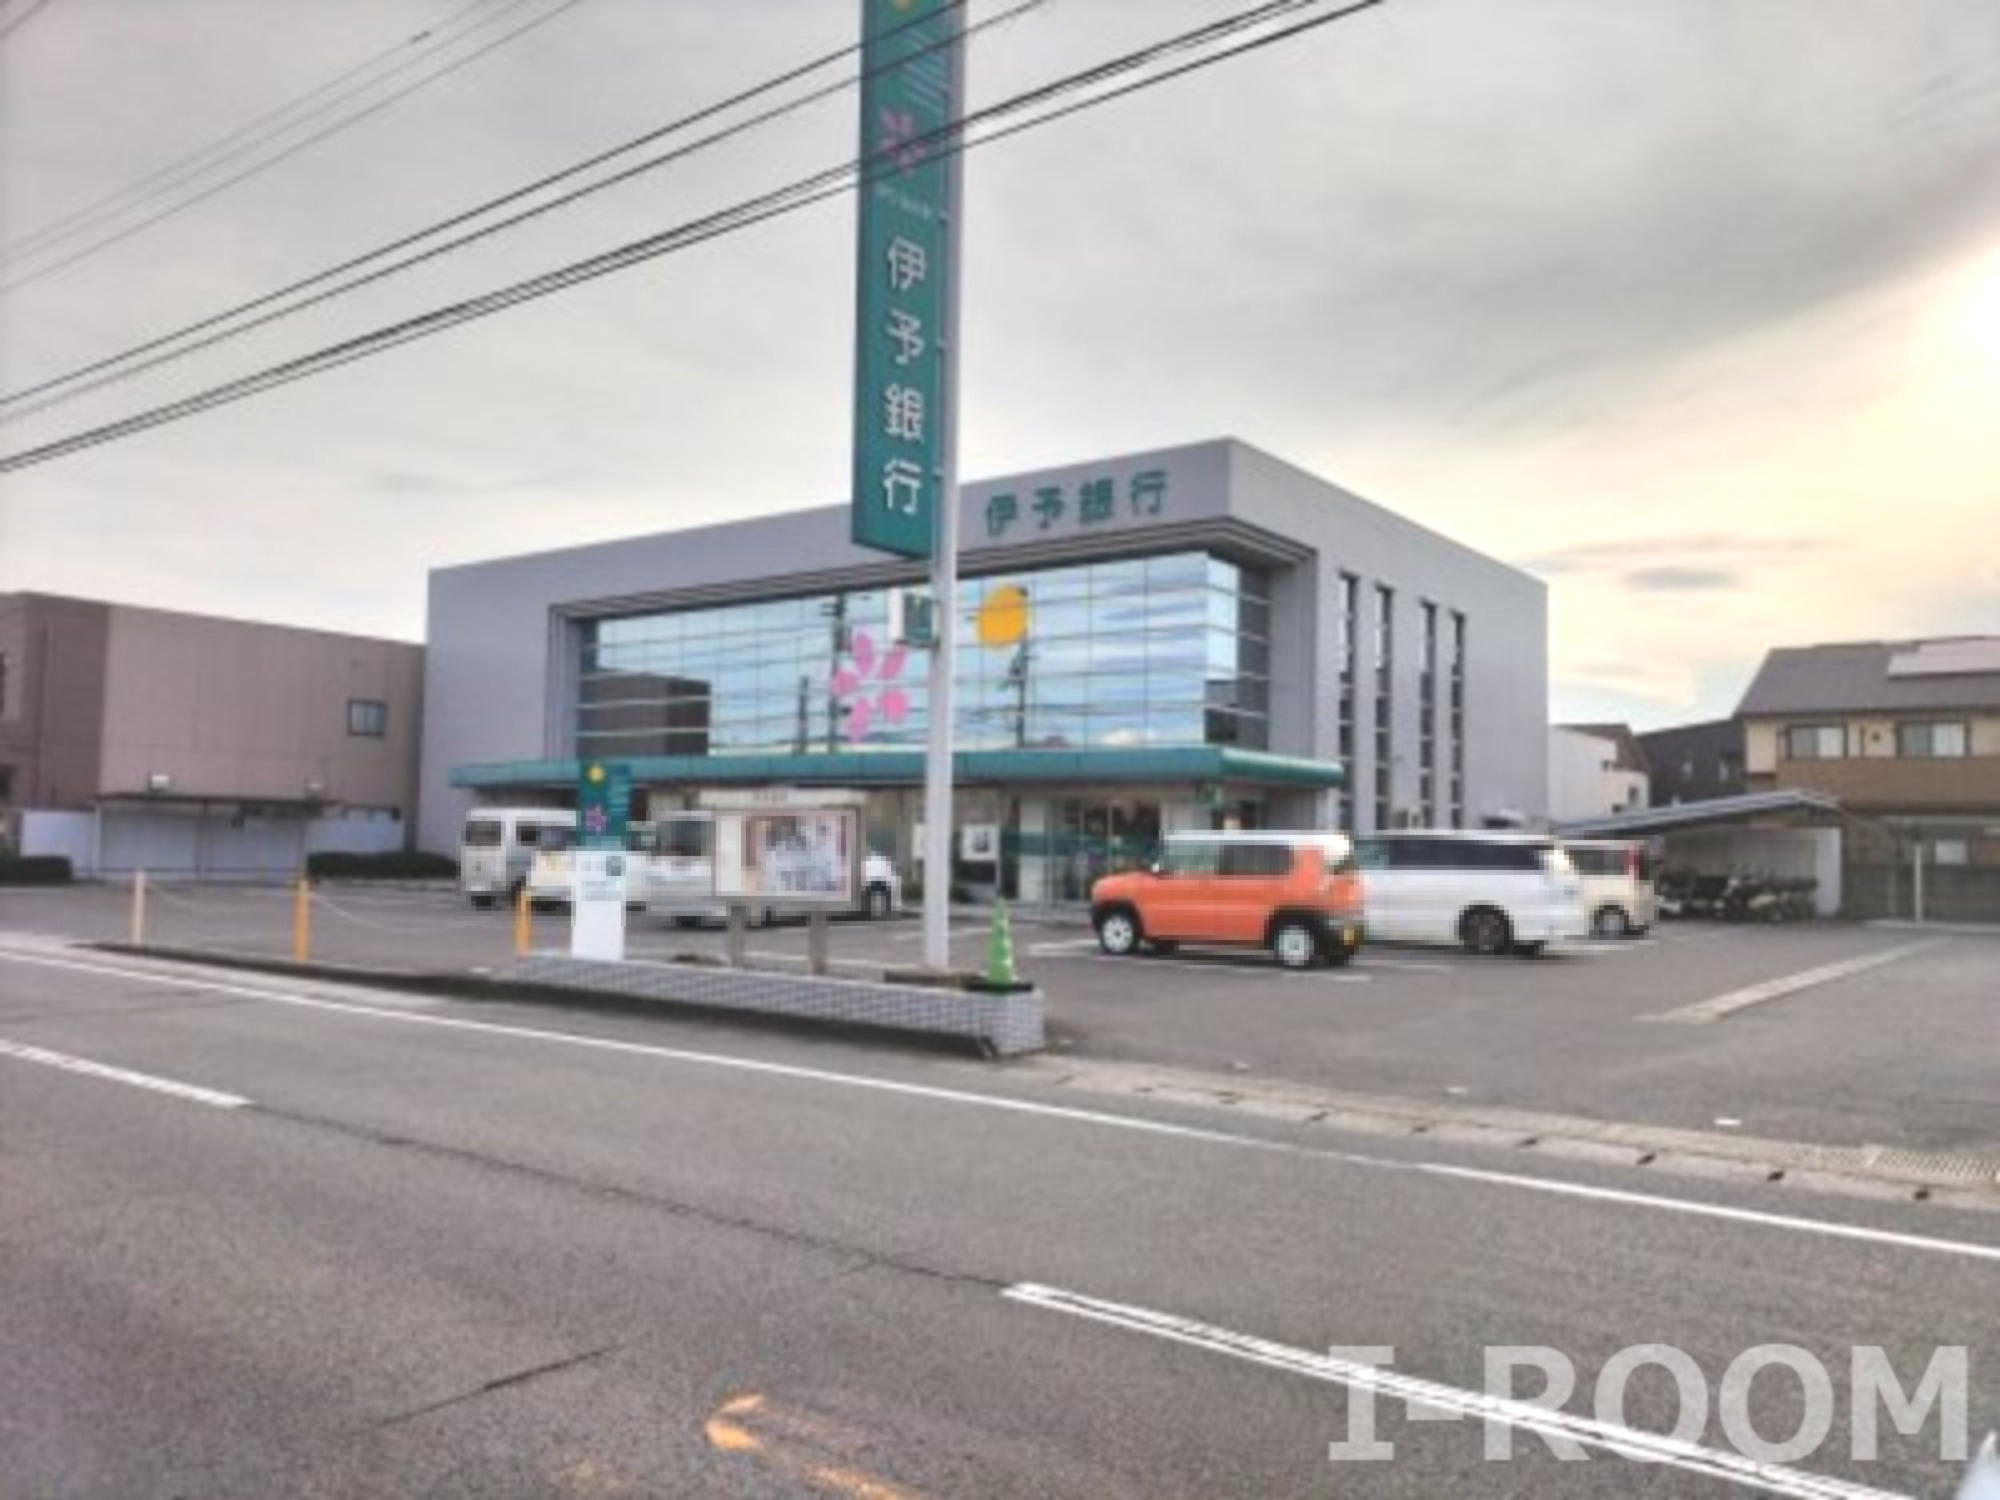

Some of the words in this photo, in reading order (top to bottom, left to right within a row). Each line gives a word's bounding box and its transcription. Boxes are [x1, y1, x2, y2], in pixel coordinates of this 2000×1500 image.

[883, 235, 927, 515] 伊予銀行
[985, 469, 1168, 538] 伊予銀行
